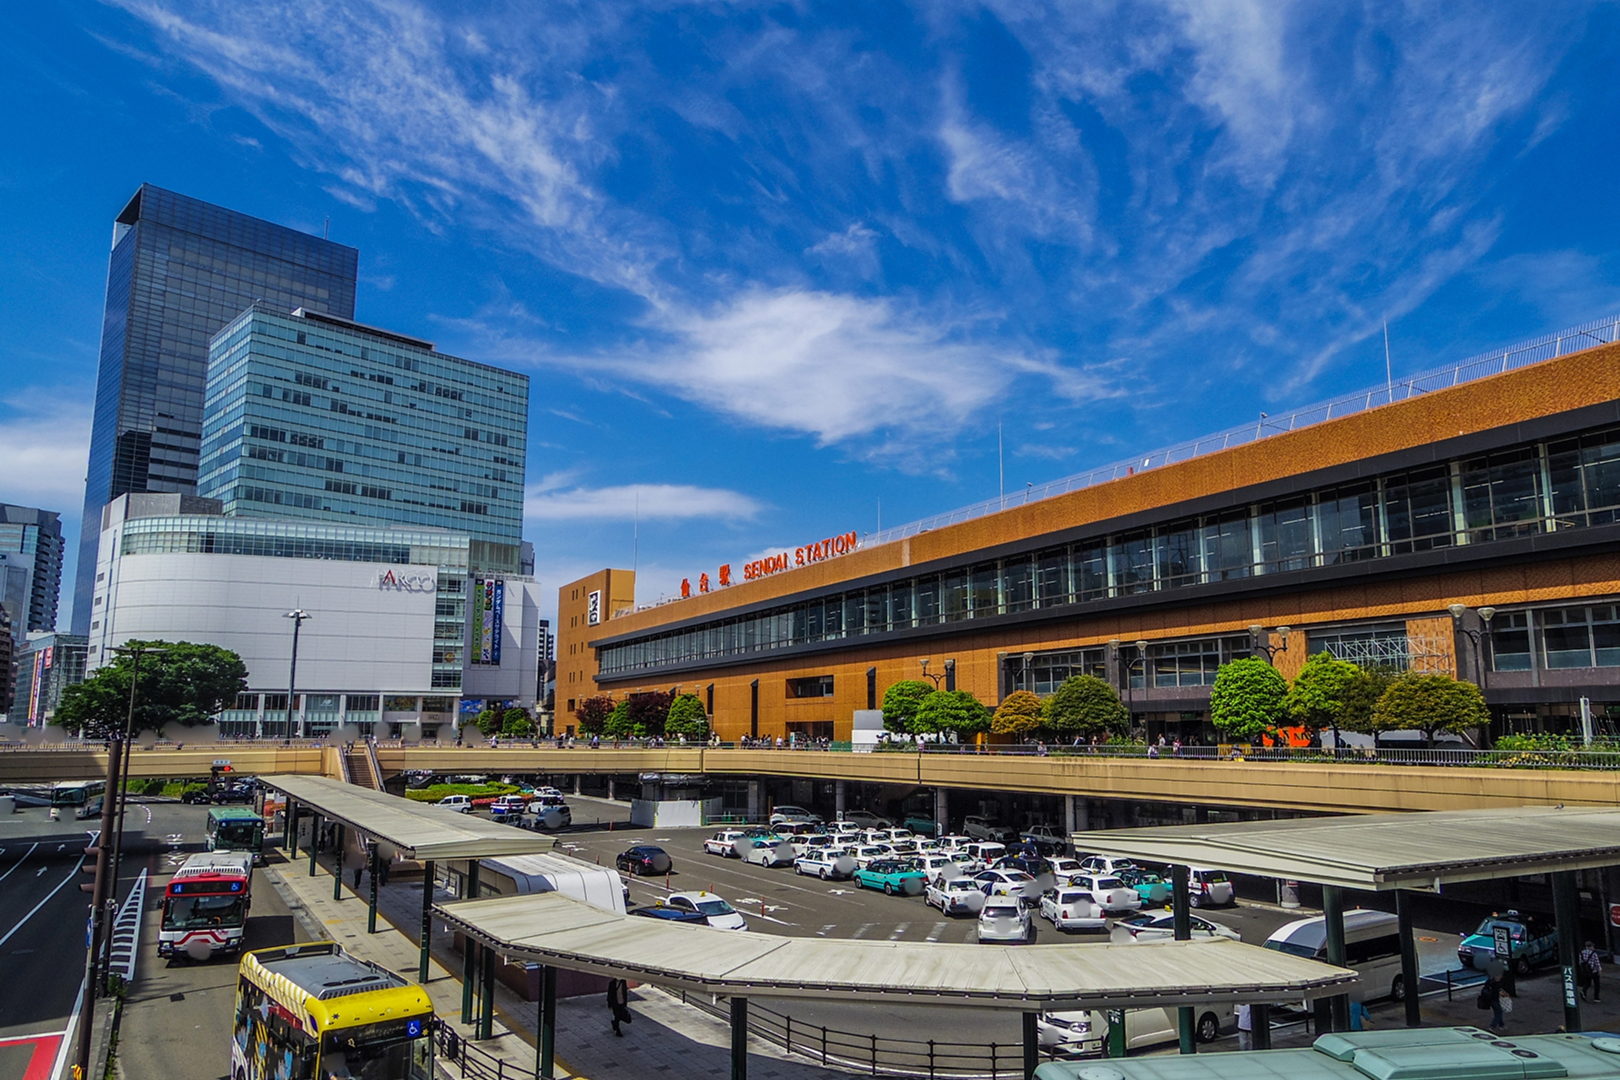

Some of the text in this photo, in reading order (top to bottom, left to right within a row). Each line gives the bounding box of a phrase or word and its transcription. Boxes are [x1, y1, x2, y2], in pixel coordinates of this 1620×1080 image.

[743, 531, 857, 579] SENDAI STATION
[377, 569, 433, 590] PARCO
[681, 564, 730, 597] 仙台駅
